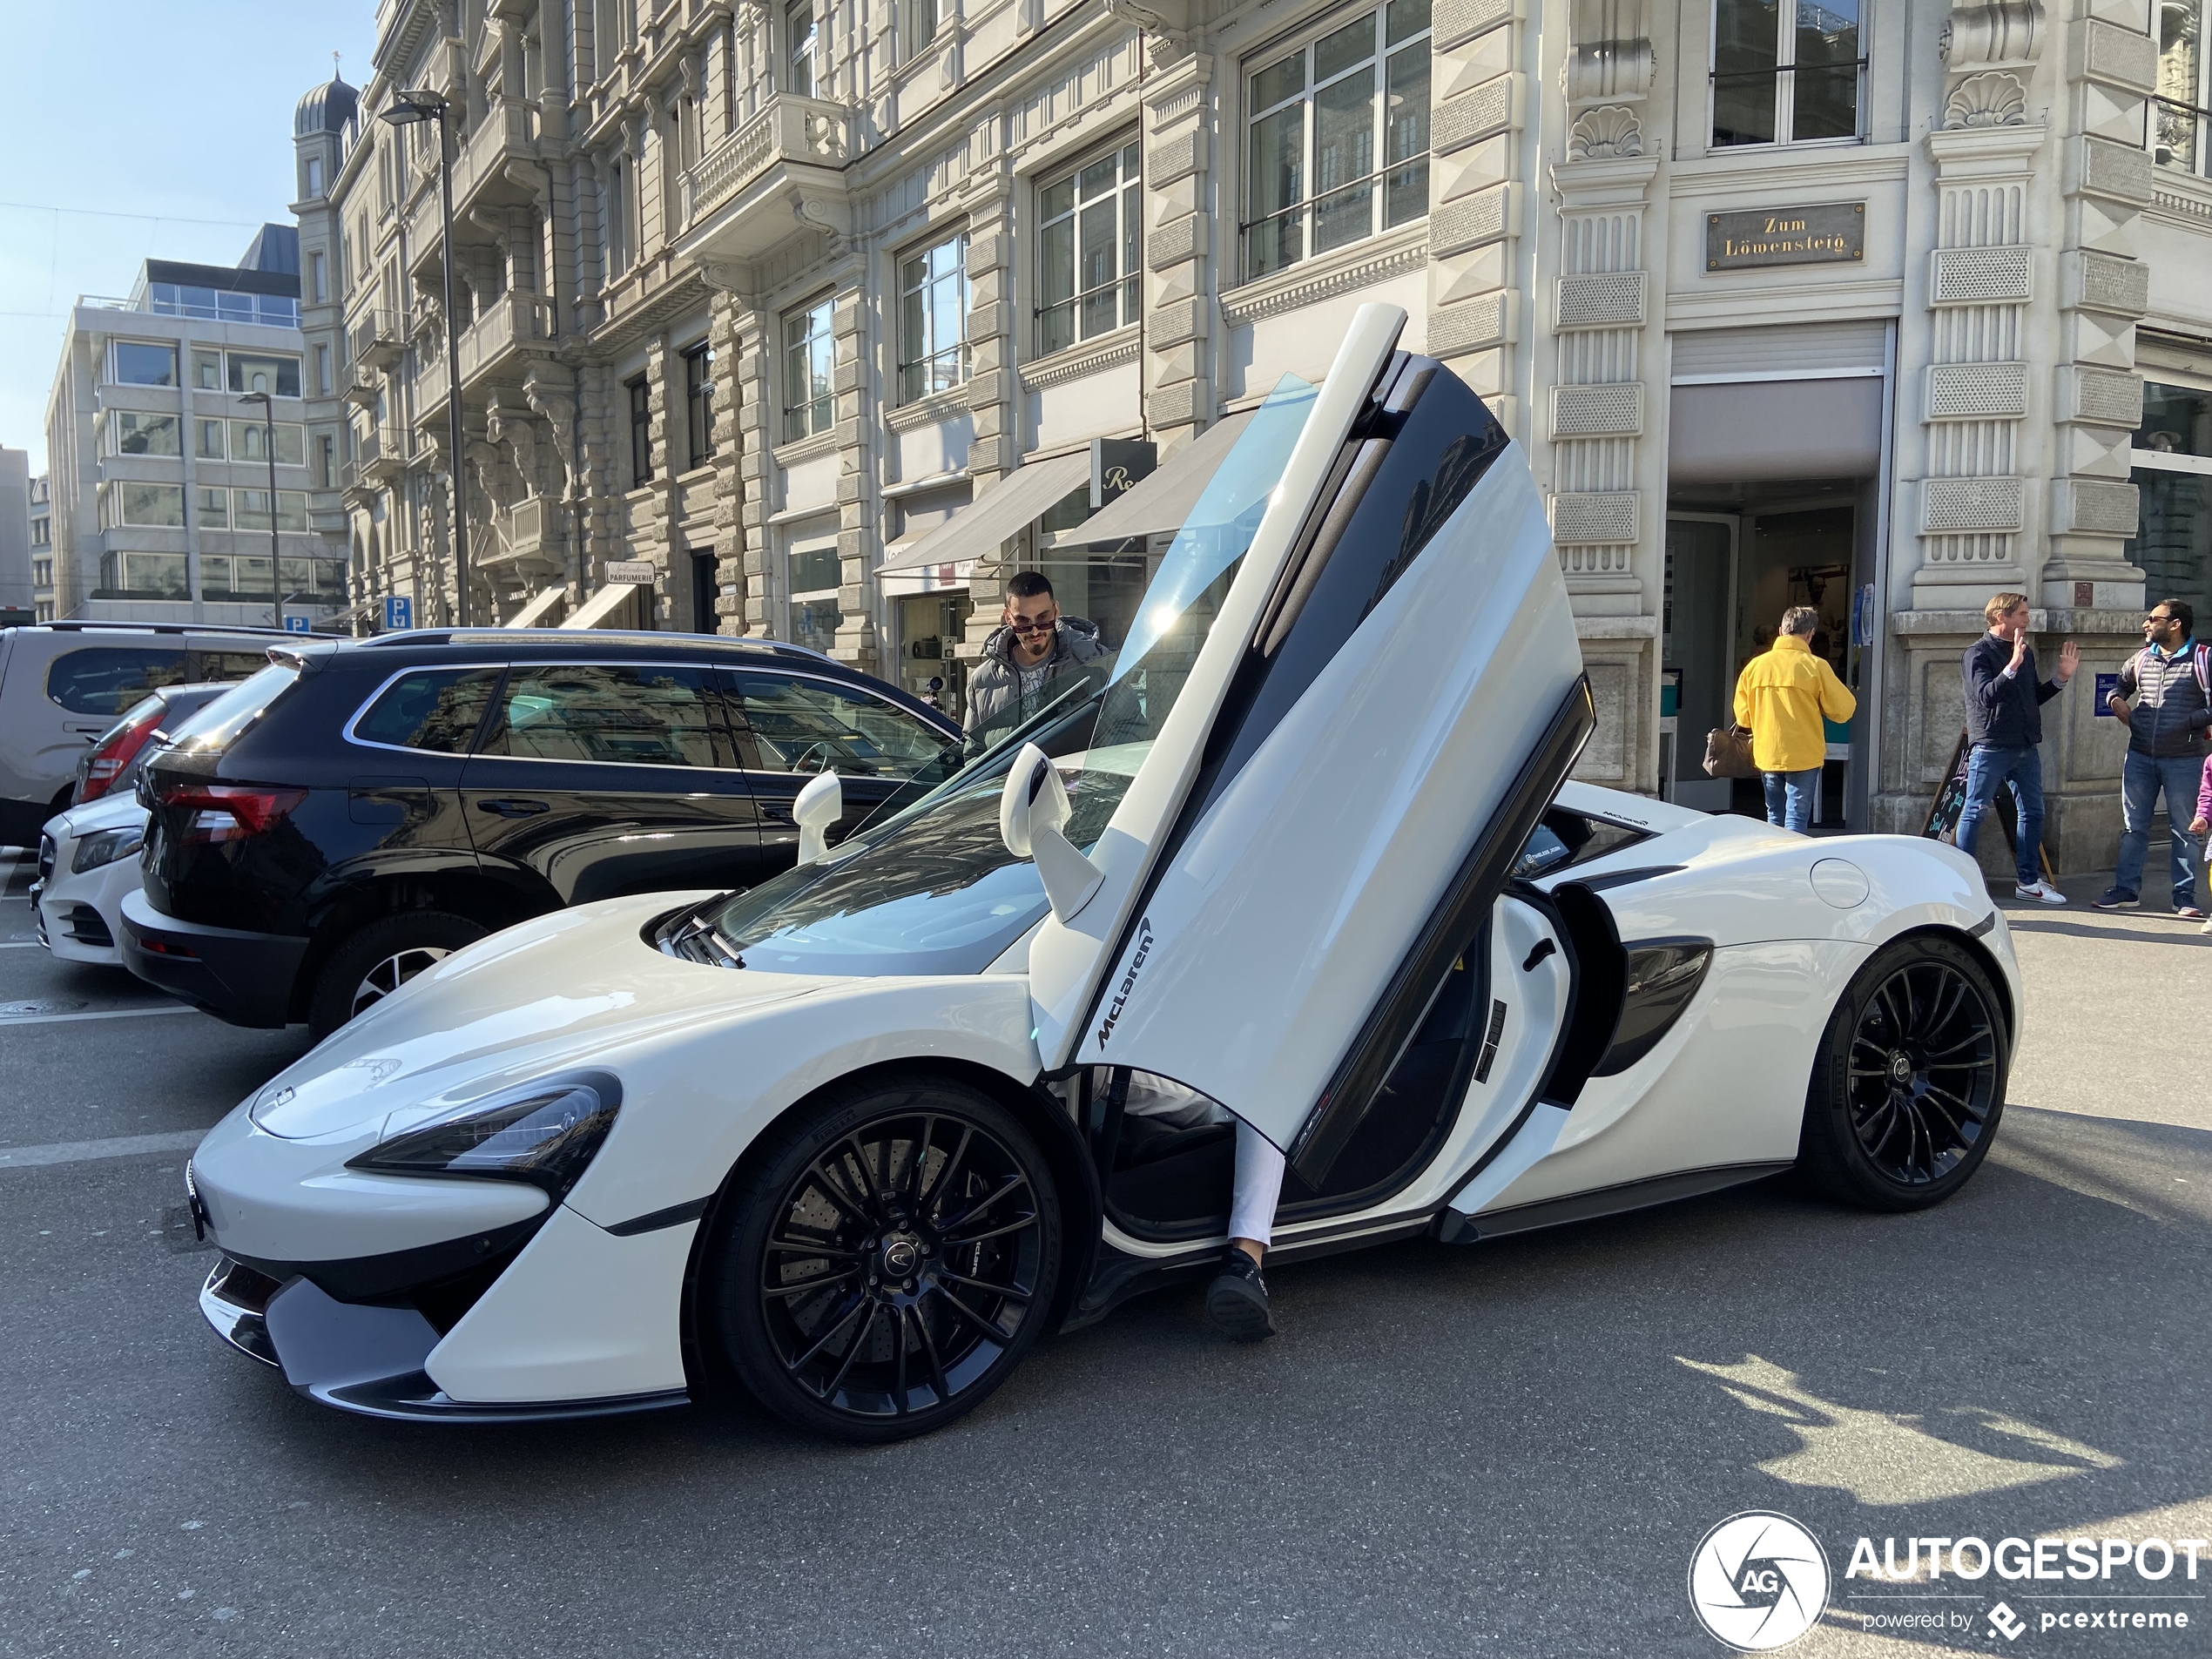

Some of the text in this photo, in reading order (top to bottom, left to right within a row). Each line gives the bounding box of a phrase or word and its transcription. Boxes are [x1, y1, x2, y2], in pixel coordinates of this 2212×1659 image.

[1764, 217, 1806, 233] Zum
[394, 599, 404, 615] P
[293, 618, 303, 632] P
[1098, 934, 1154, 1052] McLaren
